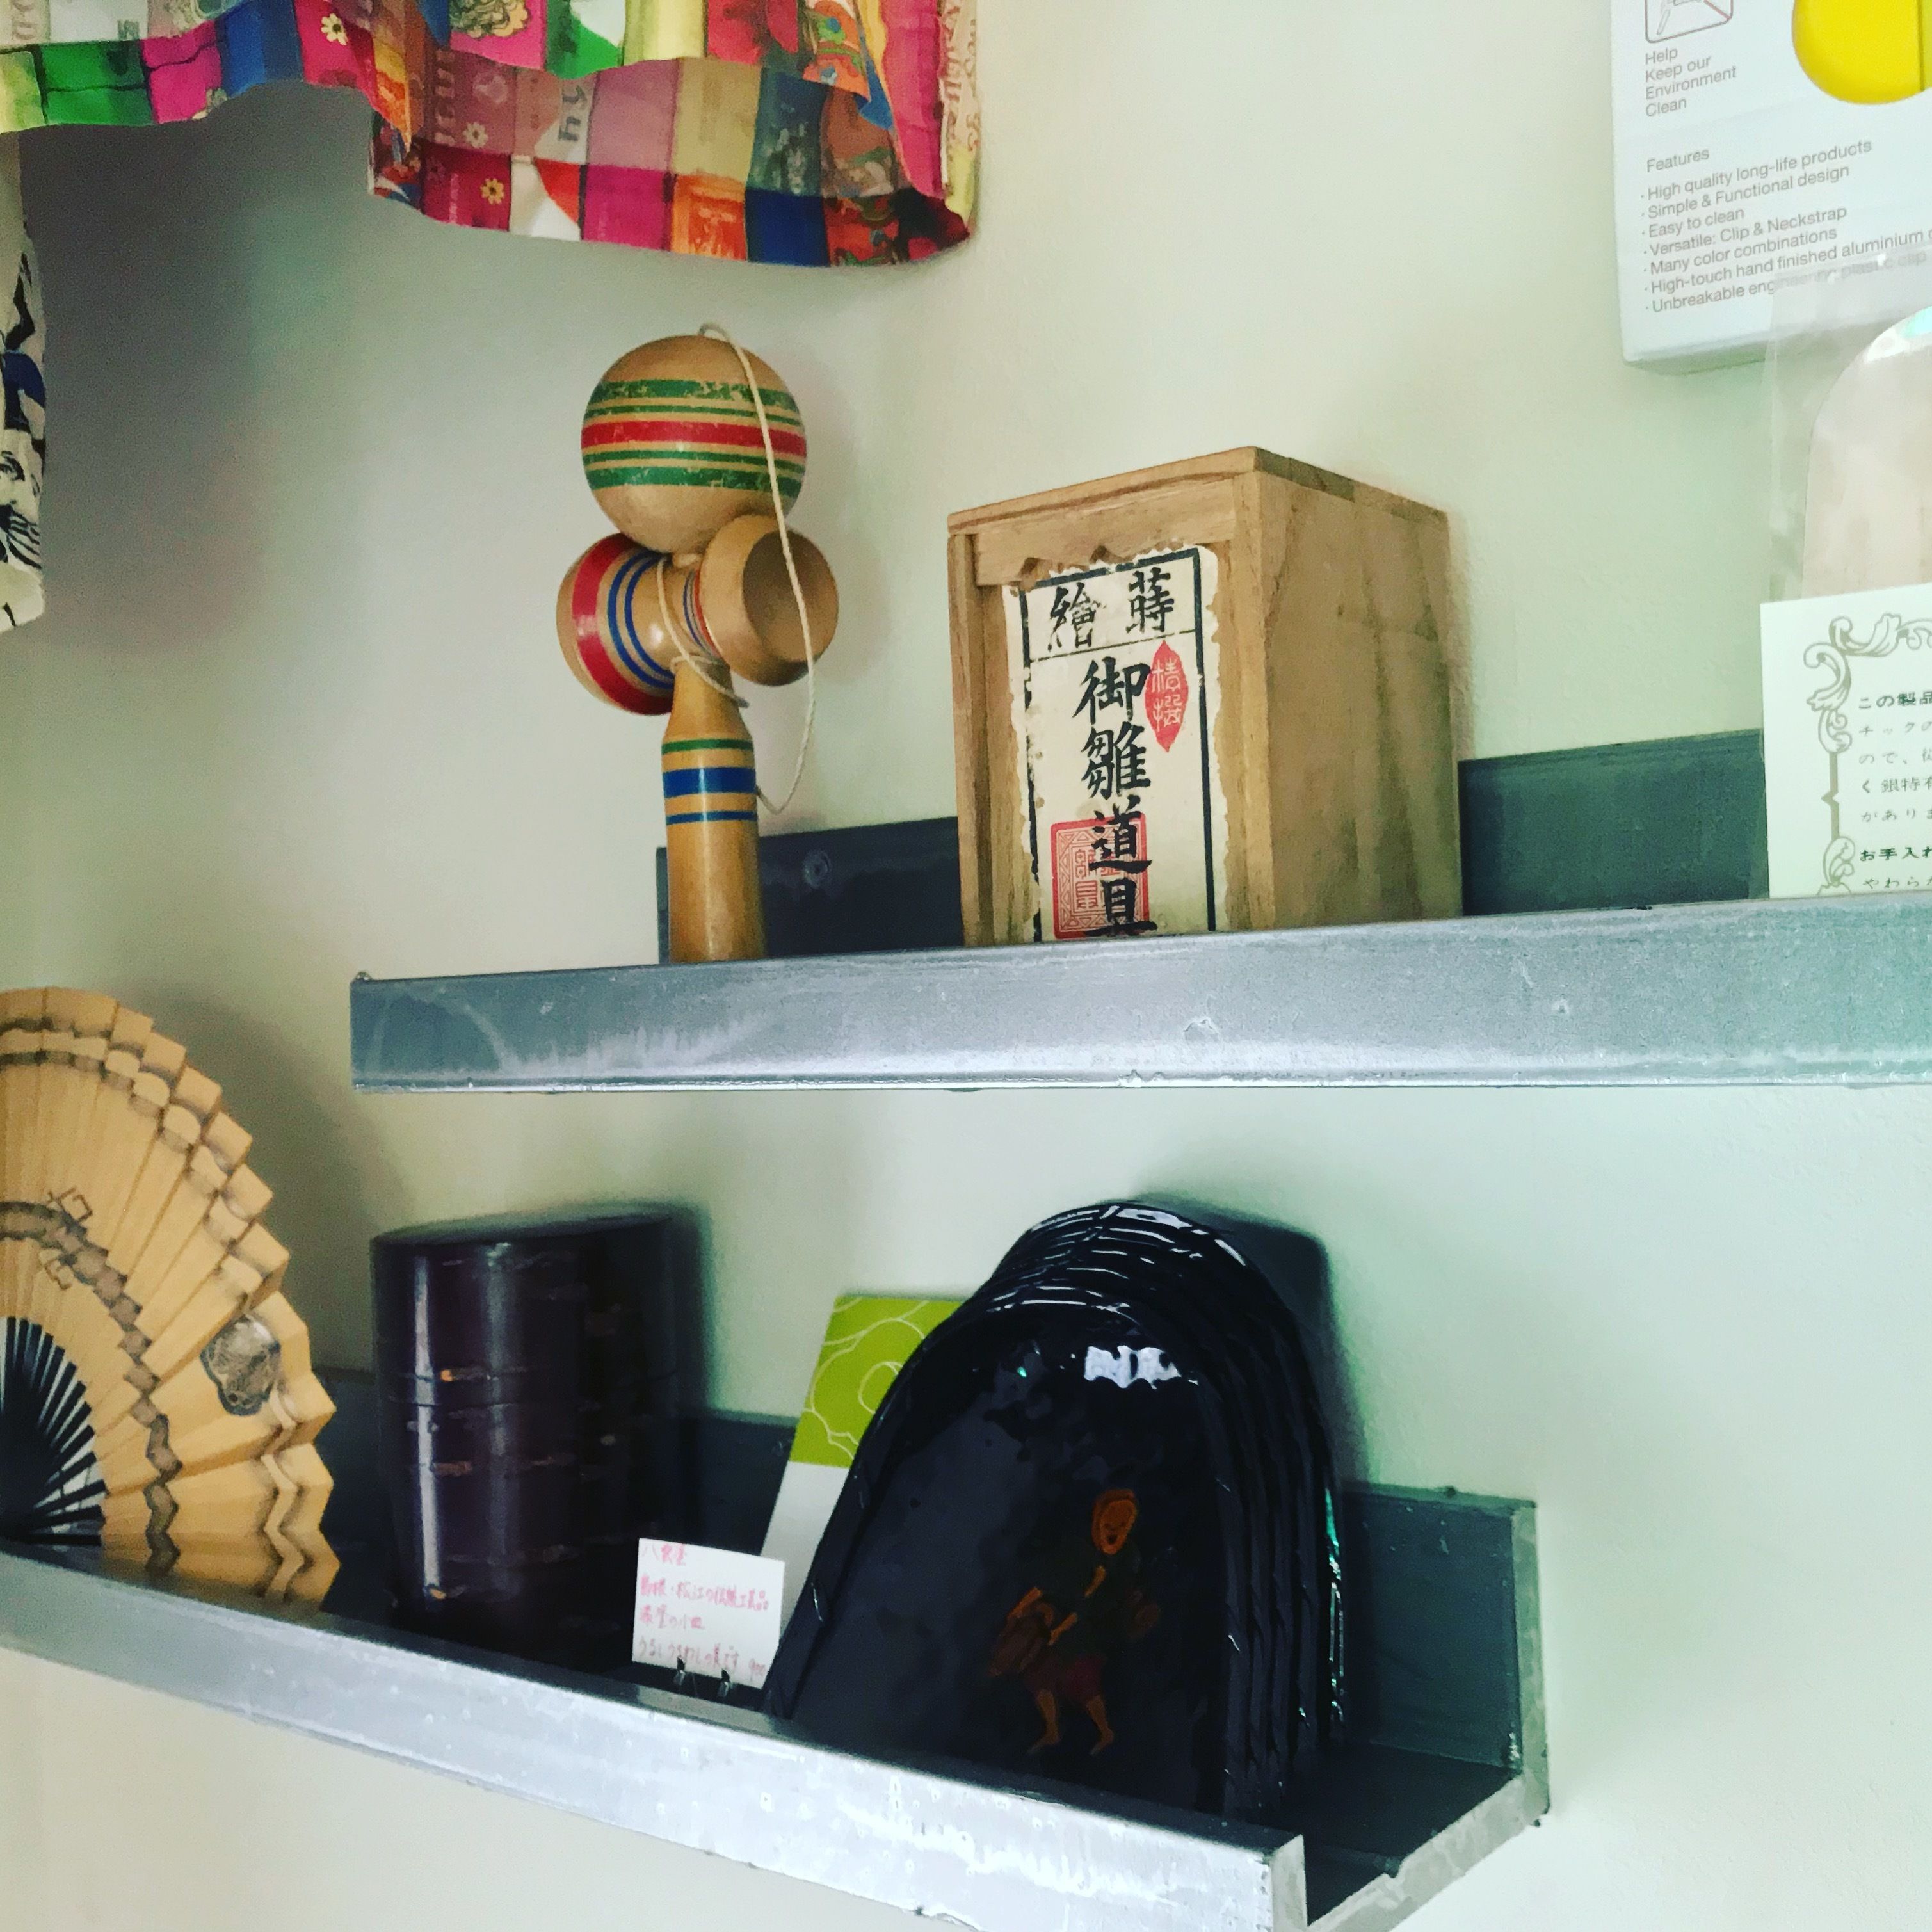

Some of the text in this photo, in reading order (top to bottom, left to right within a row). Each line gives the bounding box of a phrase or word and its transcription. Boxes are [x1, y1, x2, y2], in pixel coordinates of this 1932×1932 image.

[1645, 48, 1678, 65] Help
[1645, 56, 1711, 83] Keep our
[1646, 66, 1737, 100] Environment
[1646, 98, 1687, 117] Clean
[1646, 149, 1710, 173] Features
[1648, 140, 1872, 200] High quality long-life products
[1648, 165, 1850, 219] Simple & Functional design
[1649, 207, 1745, 237] Easy to clean
[1650, 207, 1847, 256] Versatile: Clip & Neckstrap
[1650, 229, 1838, 275] Many color combinations
[1652, 266, 1732, 295] High-touch
[1736, 257, 1774, 278] hand
[1777, 245, 1837, 270] finished
[1842, 229, 1924, 257] aluminium
[1652, 284, 1745, 313] Unbreakable
